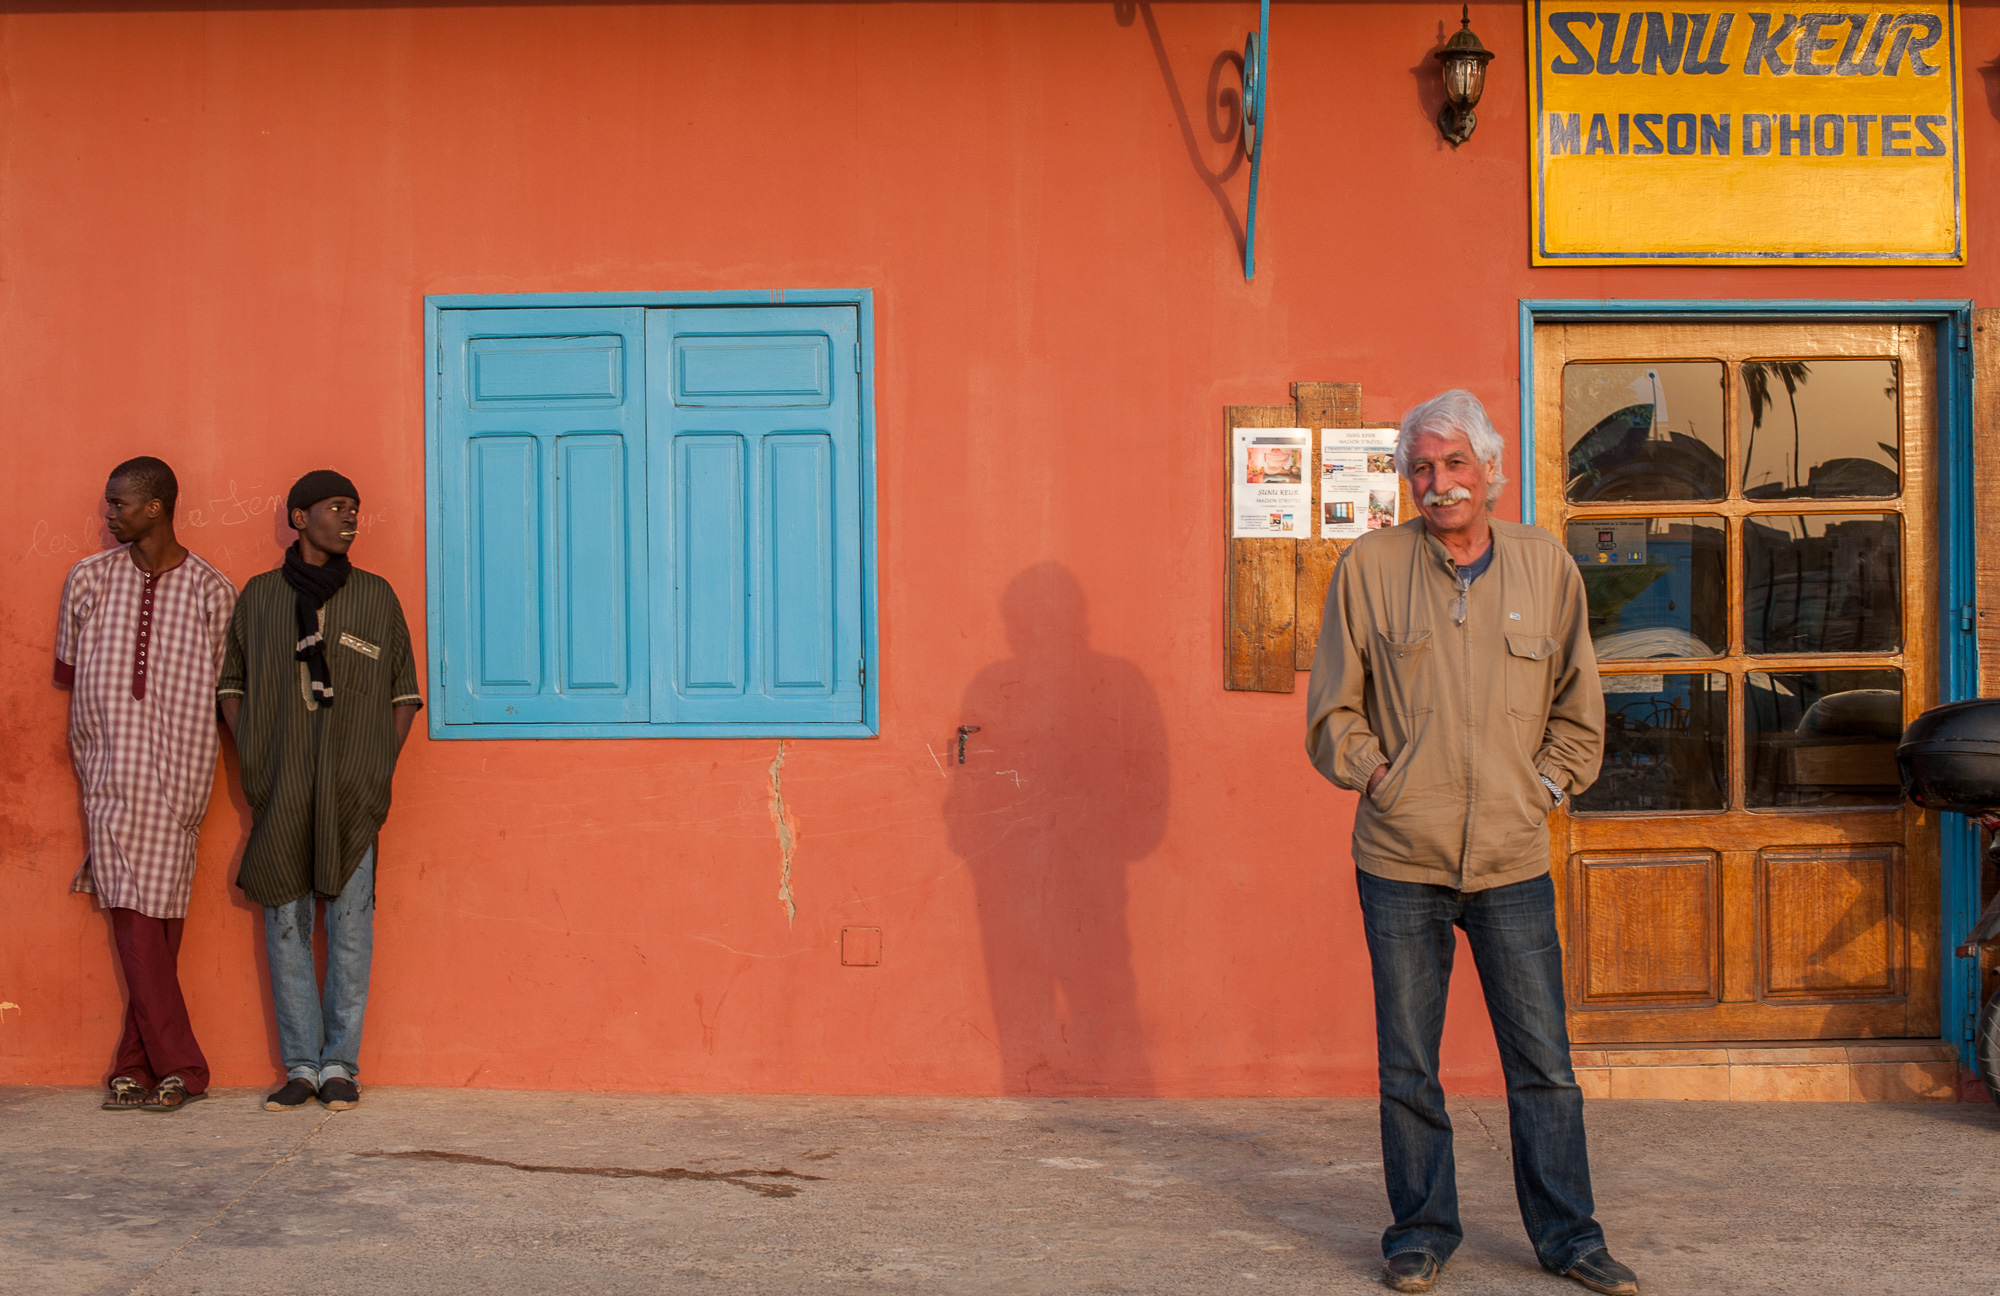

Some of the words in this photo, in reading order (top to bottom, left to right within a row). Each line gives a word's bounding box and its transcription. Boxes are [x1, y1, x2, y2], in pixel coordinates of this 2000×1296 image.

[1548, 11, 1736, 75] SUNU
[1743, 12, 1943, 77] KEUR
[1549, 112, 1731, 156] MAISON
[1742, 113, 1947, 157] D'HOTES
